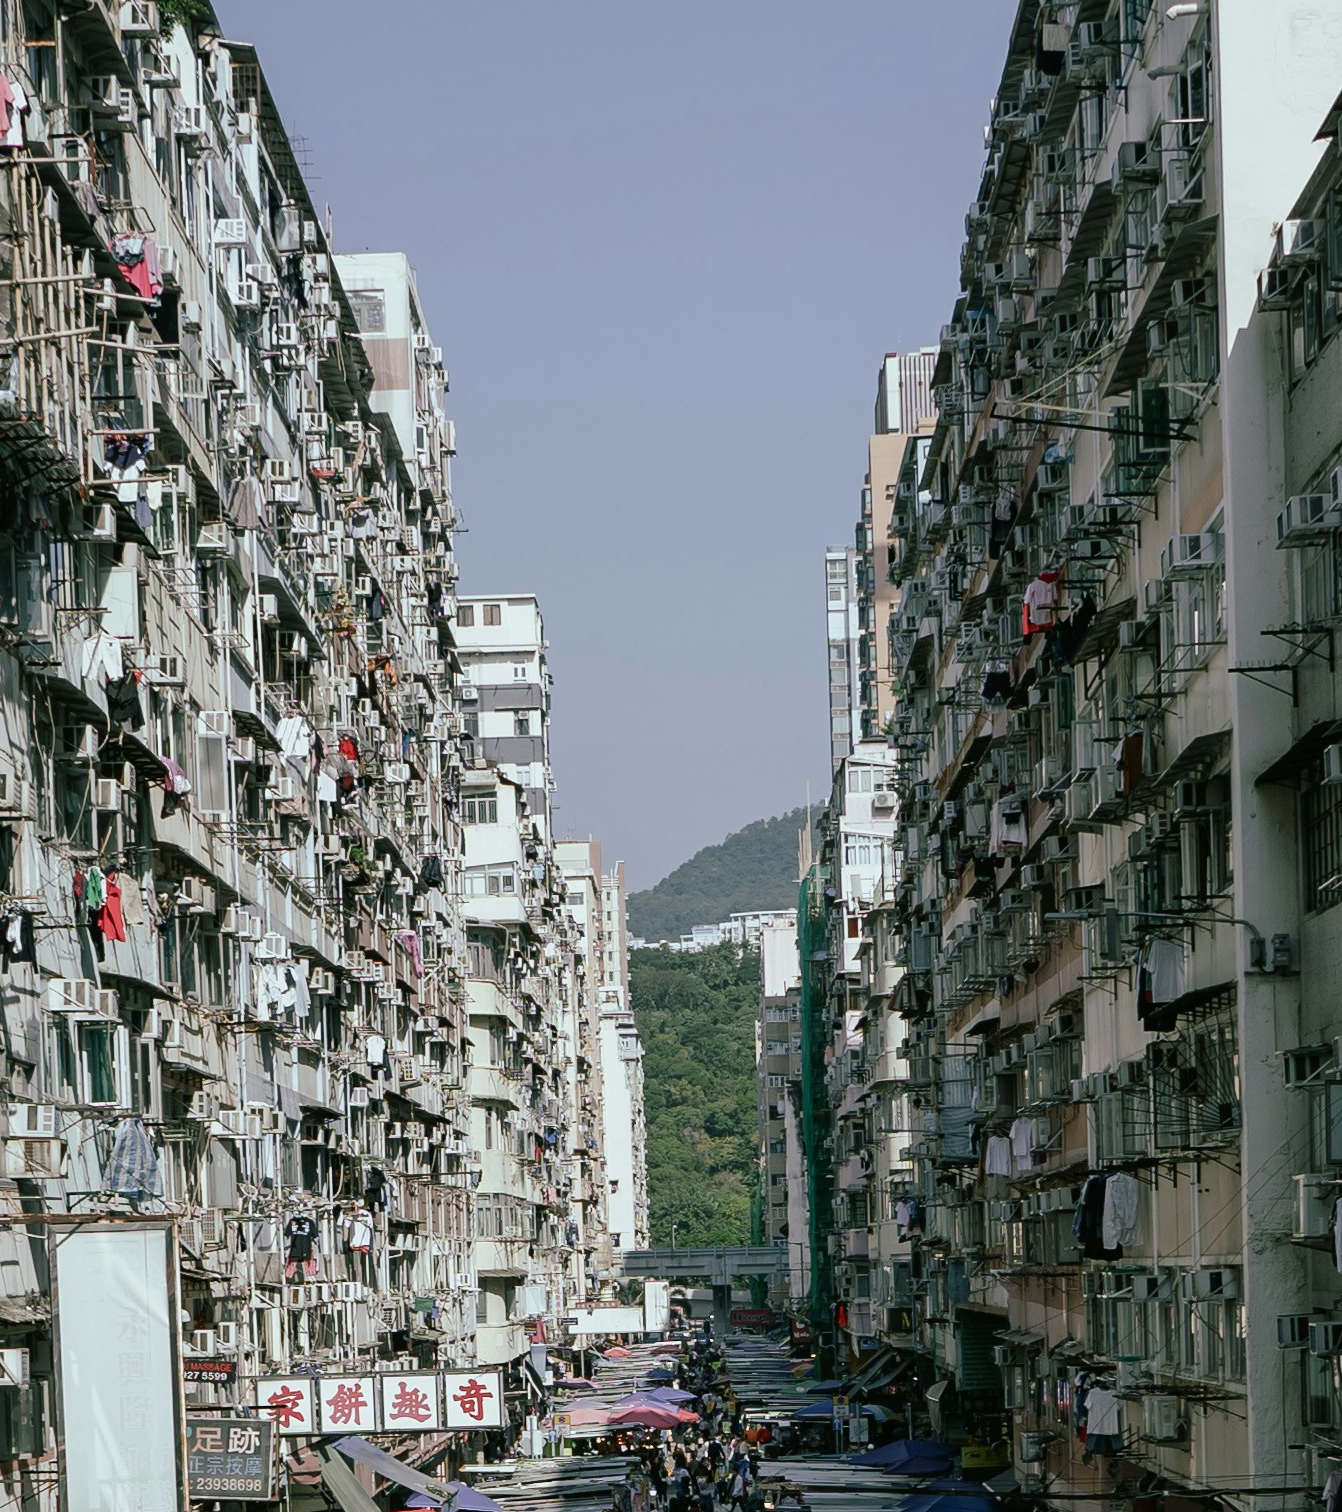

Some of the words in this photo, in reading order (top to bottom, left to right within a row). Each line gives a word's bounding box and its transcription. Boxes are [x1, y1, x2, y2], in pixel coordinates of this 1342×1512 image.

[201, 1372, 228, 1381] 5599
[192, 1426, 261, 1455] 足跡
[196, 1477, 262, 1492] 23938698
